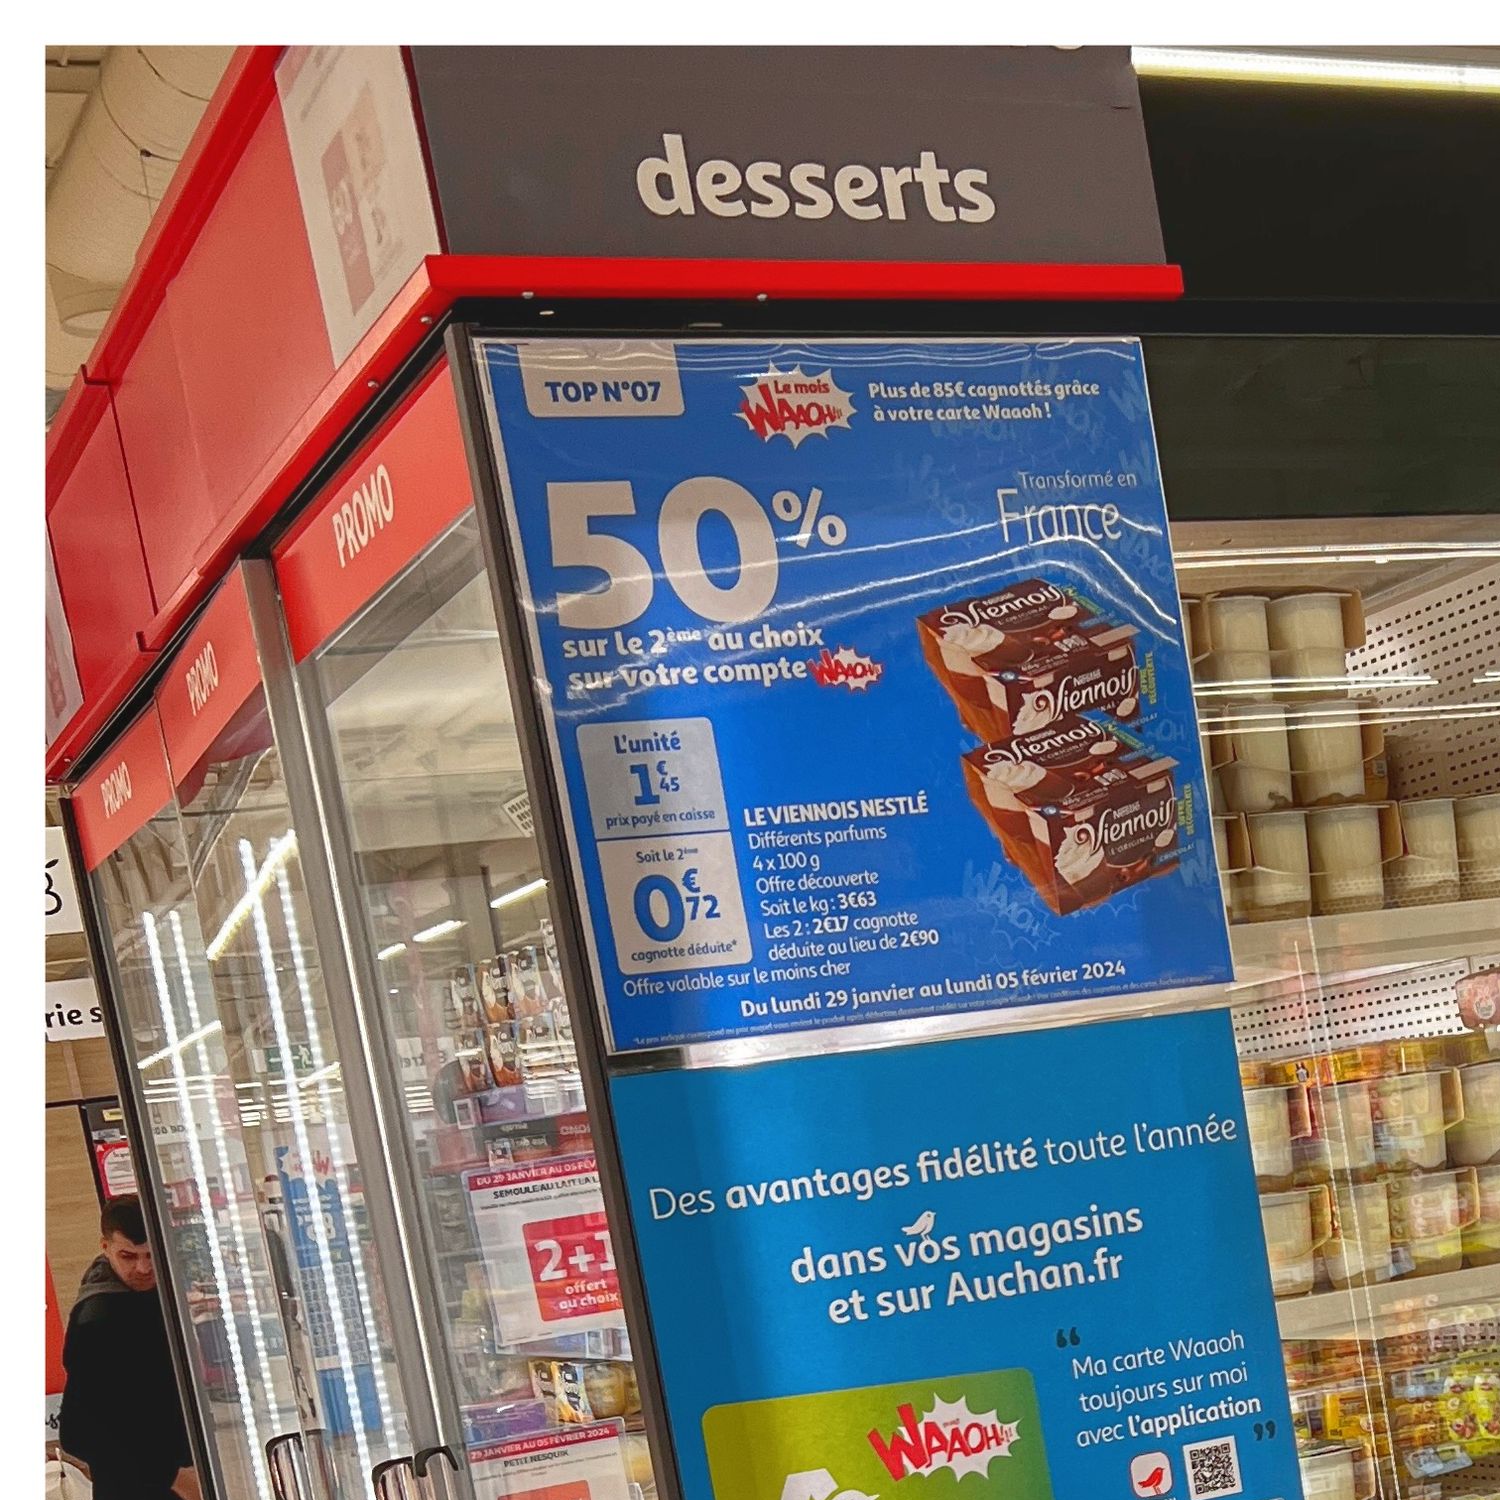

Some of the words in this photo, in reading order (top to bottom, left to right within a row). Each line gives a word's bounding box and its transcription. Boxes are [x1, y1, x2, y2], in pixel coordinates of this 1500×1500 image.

[636, 133, 996, 223] desserts
[545, 382, 597, 402] TOP
[602, 381, 660, 402] N°07
[774, 379, 791, 395] Le
[794, 380, 830, 394] mois
[868, 383, 906, 398] Plus
[910, 382, 930, 398] de
[933, 382, 964, 397] 85€
[968, 381, 1051, 400] cagnottés
[1054, 381, 1099, 400] grâce
[874, 404, 884, 421] à
[887, 407, 933, 421] votre
[936, 406, 980, 420] carte
[983, 404, 1042, 419] Waaoh
[1017, 471, 1114, 489] Transformé
[1117, 474, 1137, 487] en
[332, 464, 394, 567] PROMO
[997, 488, 1122, 543] France
[563, 638, 608, 659] sur
[614, 631, 642, 656] le
[649, 629, 700, 654] 2ème
[709, 632, 744, 650] au
[749, 621, 823, 649] choix
[186, 641, 219, 716] PROMO
[569, 672, 612, 691] sur
[622, 663, 698, 688] votre
[704, 657, 807, 687] compte
[614, 732, 681, 754] L'unité
[101, 762, 132, 817] PROMO
[744, 808, 768, 828] LE
[768, 800, 859, 825] VIENNOIS
[860, 791, 929, 818] NESTLÉ
[748, 830, 821, 849] Différents
[825, 827, 886, 846] parfums
[756, 879, 796, 894] Offre
[799, 870, 878, 890] découverte
[741, 1000, 768, 1017] Du
[771, 992, 821, 1014] lundi
[826, 989, 847, 1008] 29
[852, 984, 914, 1010] janvier
[921, 982, 942, 998] au
[946, 975, 992, 995] lundi
[996, 973, 1018, 989] 05
[1021, 968, 1078, 986] février
[1082, 960, 1126, 980] 2024
[650, 1188, 715, 1220] Des
[726, 1162, 910, 1209] avantages
[917, 1137, 1037, 1182] fidélité
[1044, 1132, 1126, 1165] toute
[1134, 1113, 1237, 1152] l'année
[791, 1246, 887, 1283] dans
[894, 1235, 960, 1267] vos
[969, 1204, 1143, 1256] magasins
[560, 1298, 578, 1309] au
[580, 1293, 618, 1306] choix
[565, 1279, 607, 1294] offert
[828, 1290, 869, 1324] et
[876, 1284, 934, 1317] sur
[946, 1247, 1122, 1306] Auchan.fr
[1072, 1356, 1107, 1379] Ma
[1112, 1346, 1166, 1372] carte
[1169, 1329, 1244, 1360] Waaoh
[1079, 1382, 1167, 1412] toujours
[1173, 1376, 1203, 1396] sur
[1209, 1362, 1248, 1388] moi
[1076, 1423, 1125, 1447] avec
[1128, 1397, 1261, 1438] l'application
